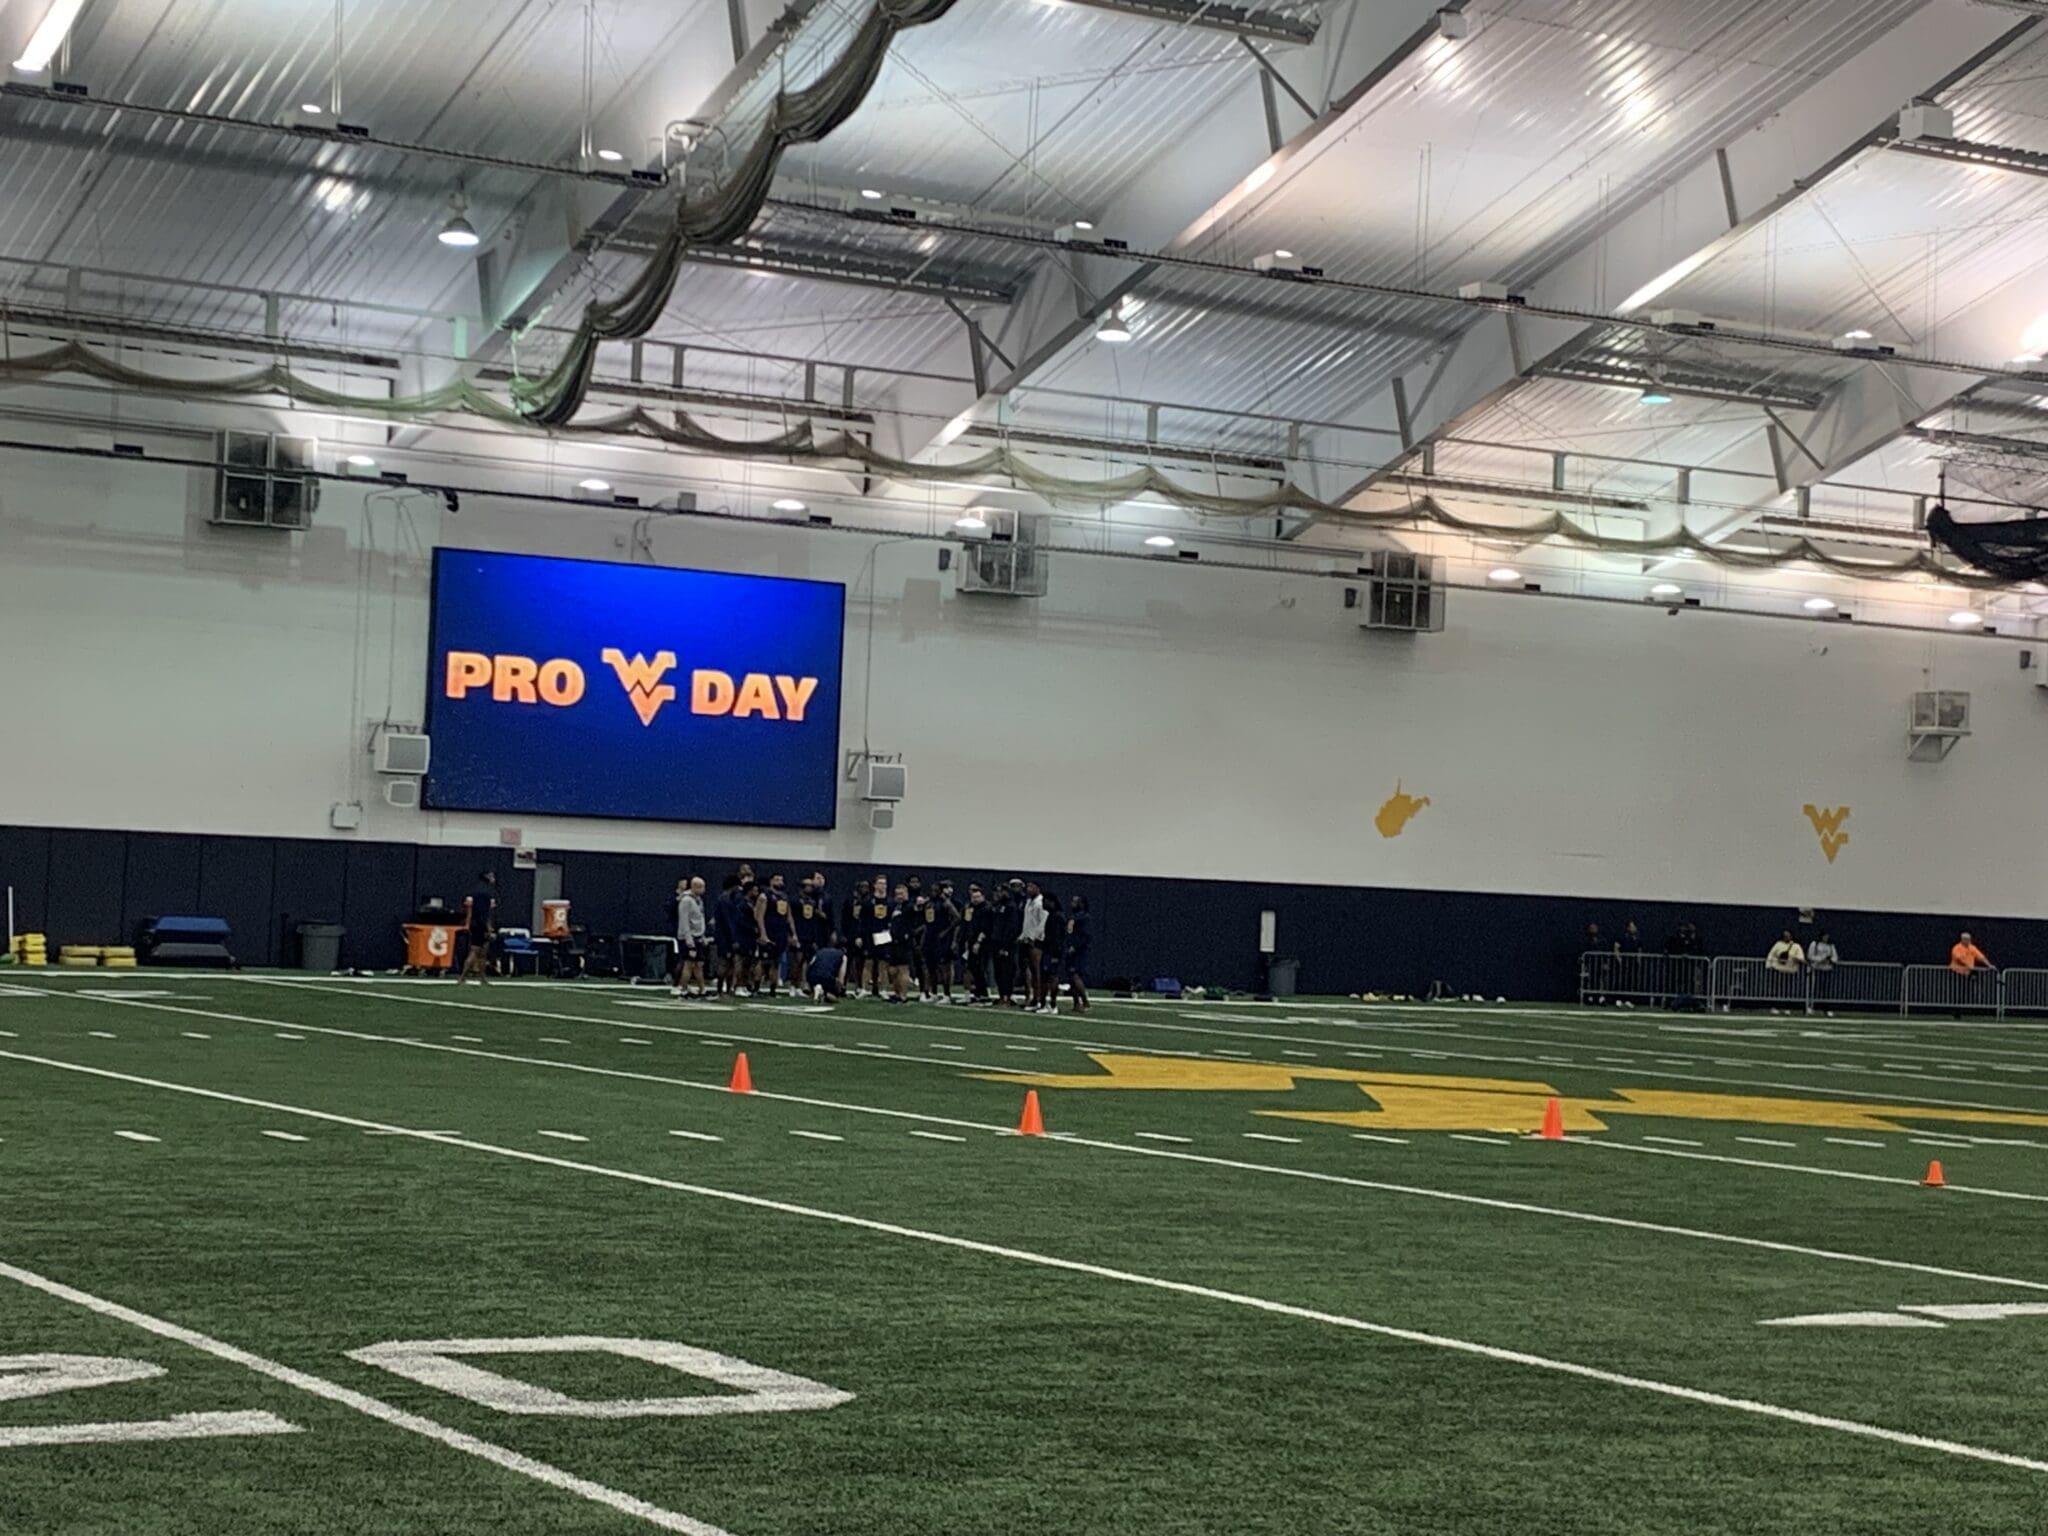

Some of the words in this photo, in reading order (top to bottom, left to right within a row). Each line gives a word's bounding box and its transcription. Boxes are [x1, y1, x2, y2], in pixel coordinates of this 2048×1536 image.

[447, 651, 586, 706] PRO
[602, 648, 677, 726] WV
[691, 669, 819, 721] DAY
[1803, 804, 1850, 865] WV
